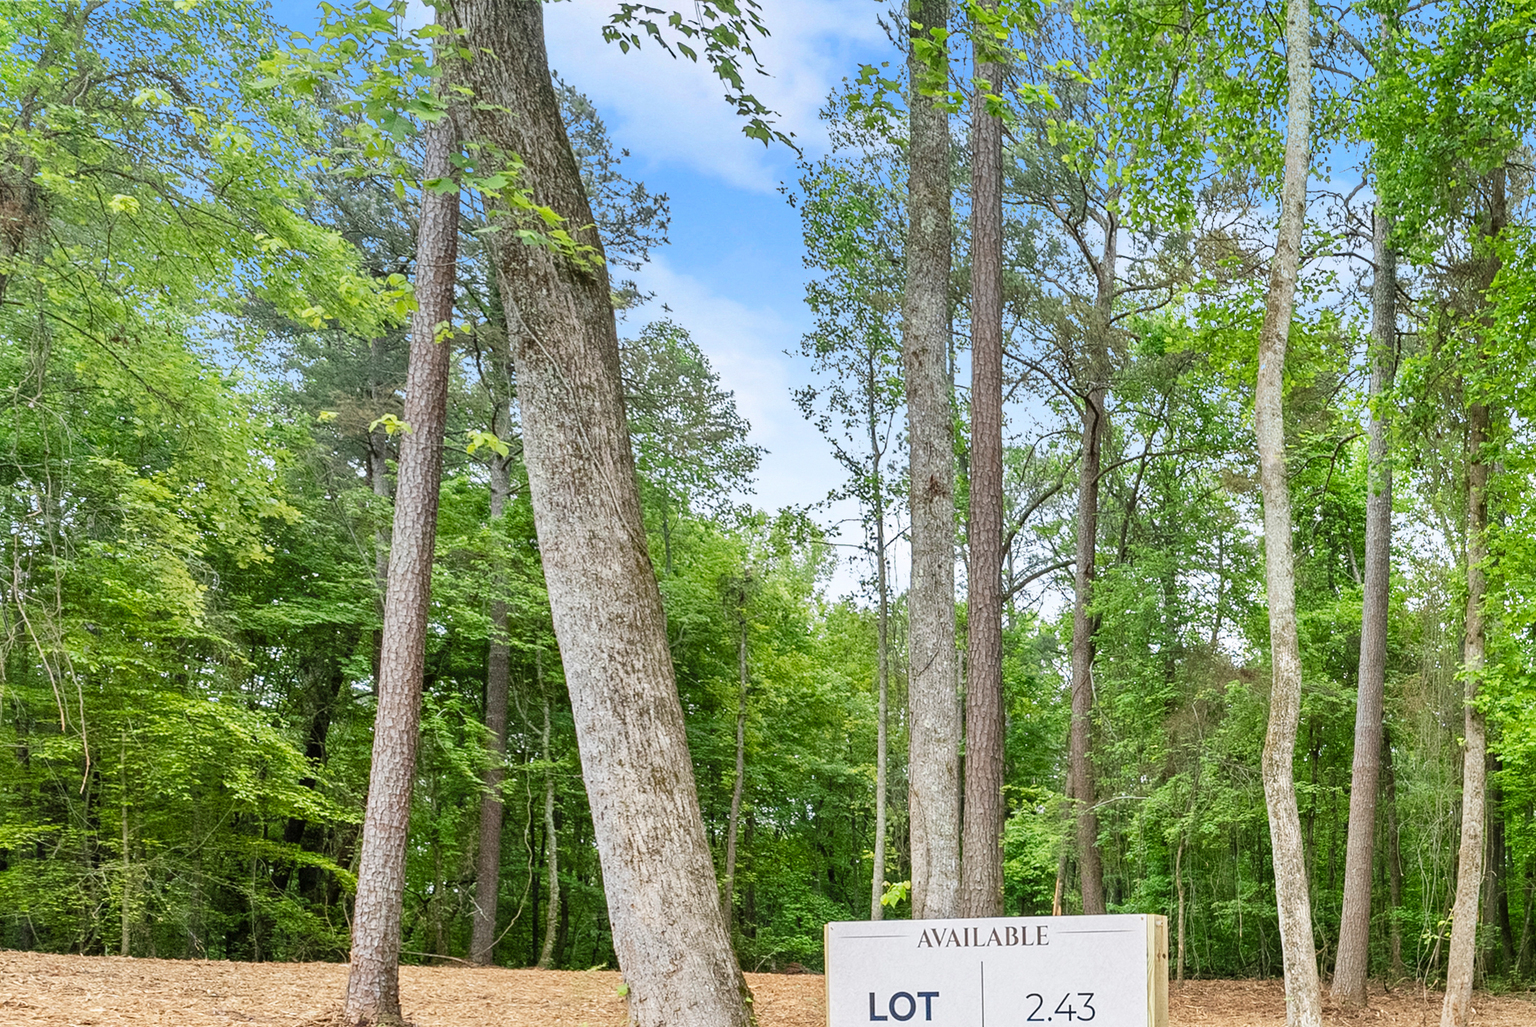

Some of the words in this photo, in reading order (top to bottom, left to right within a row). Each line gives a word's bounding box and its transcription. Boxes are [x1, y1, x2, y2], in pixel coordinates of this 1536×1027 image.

[917, 925, 1049, 949] AVAILABLE
[869, 991, 939, 1021] LOT
[1025, 992, 1096, 1022] 2.43
